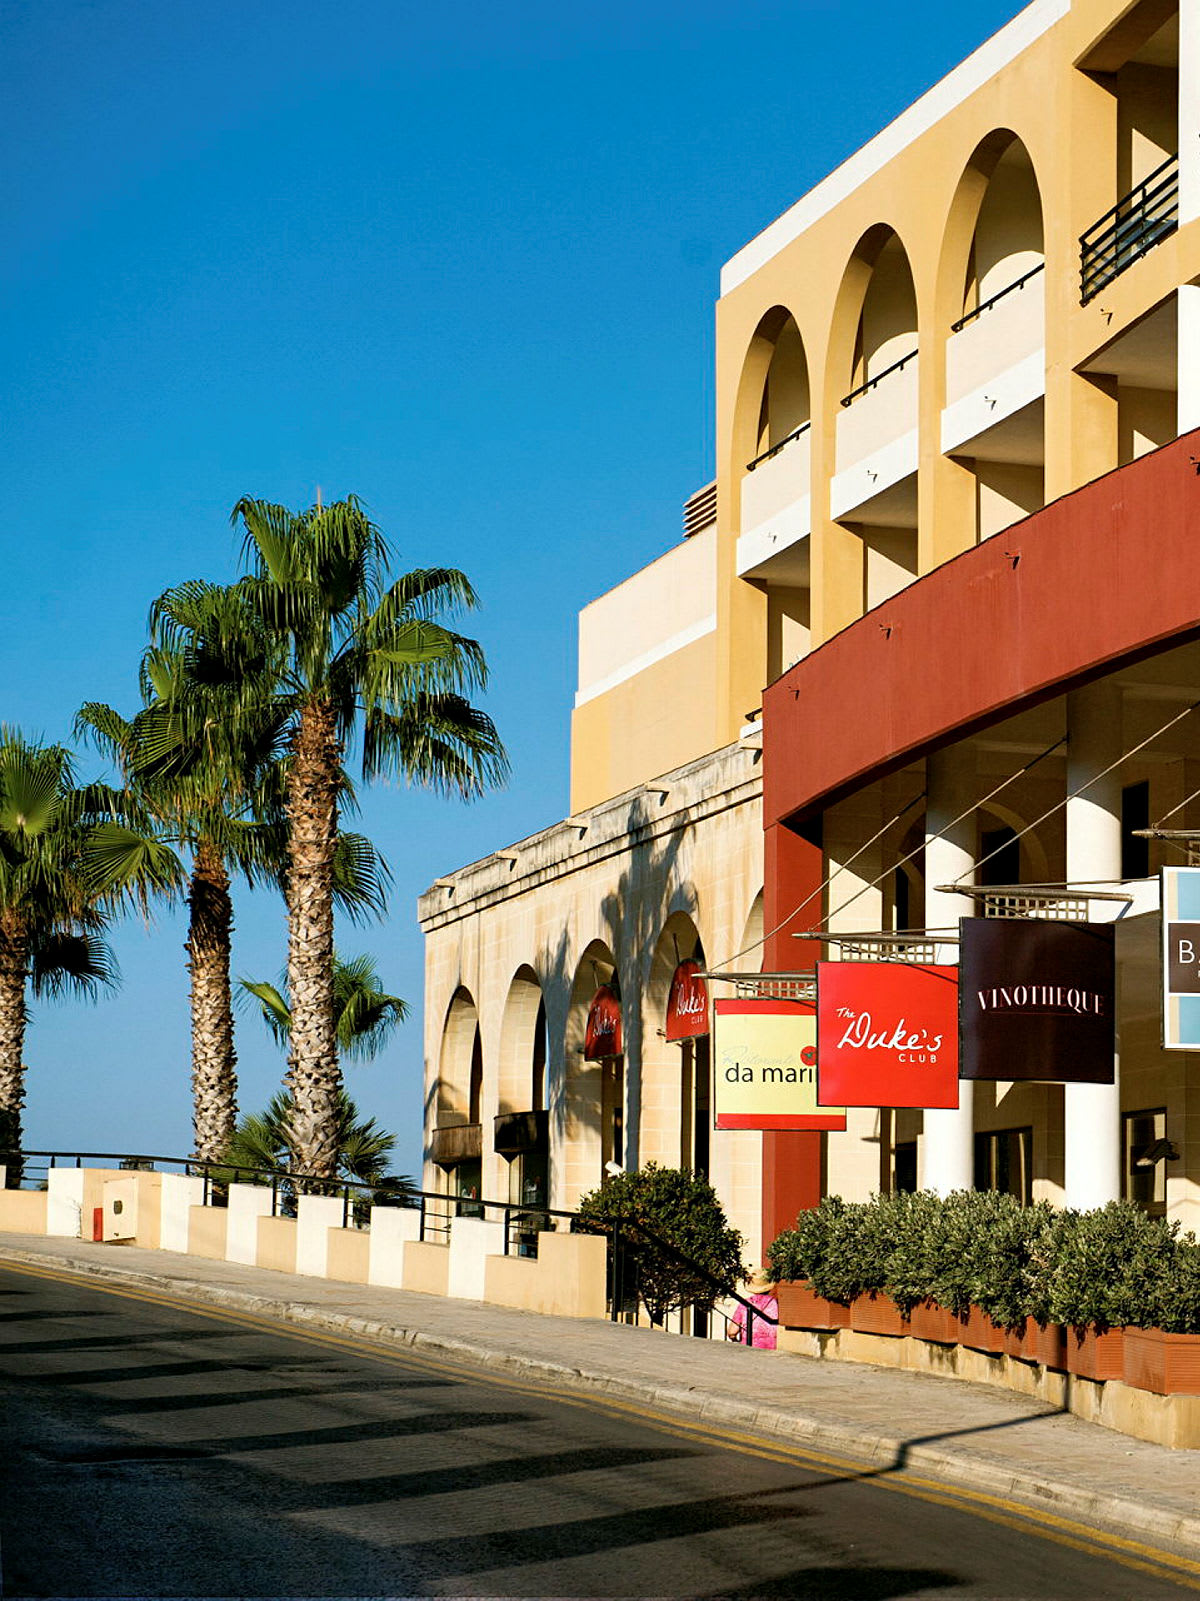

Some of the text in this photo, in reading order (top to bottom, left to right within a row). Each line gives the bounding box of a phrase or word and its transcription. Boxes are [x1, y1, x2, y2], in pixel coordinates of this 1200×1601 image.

[978, 985, 1105, 1016] VINOTHEQUE
[836, 1007, 856, 1018] The
[837, 1012, 943, 1052] Duke's
[898, 1053, 937, 1063] CLUB
[725, 1062, 817, 1083] da mari
